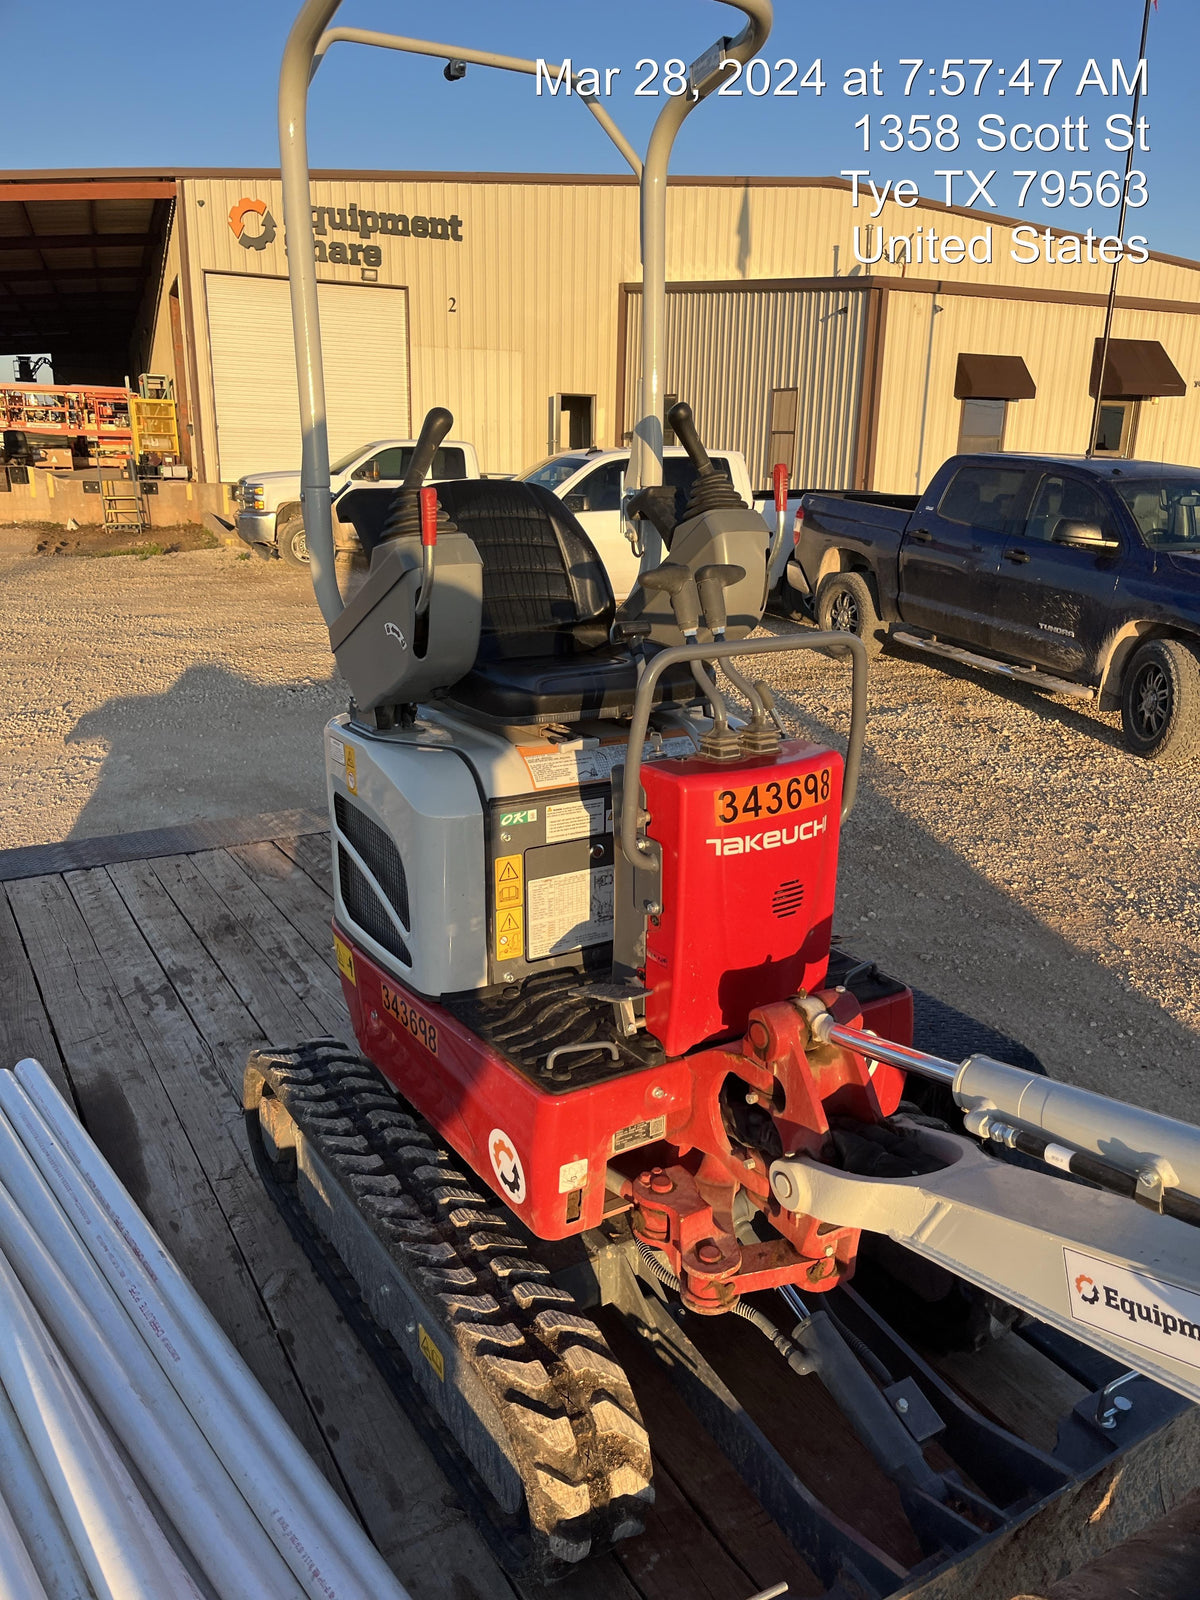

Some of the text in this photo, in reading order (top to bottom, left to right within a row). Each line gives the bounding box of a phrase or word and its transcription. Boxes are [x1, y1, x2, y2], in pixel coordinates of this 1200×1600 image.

[284, 203, 463, 241] quipment
[284, 233, 382, 267] hare
[447, 297, 457, 313] 2
[1038, 622, 1075, 638] TUNDRA
[719, 769, 829, 824] 343698
[381, 984, 437, 1053] 343698
